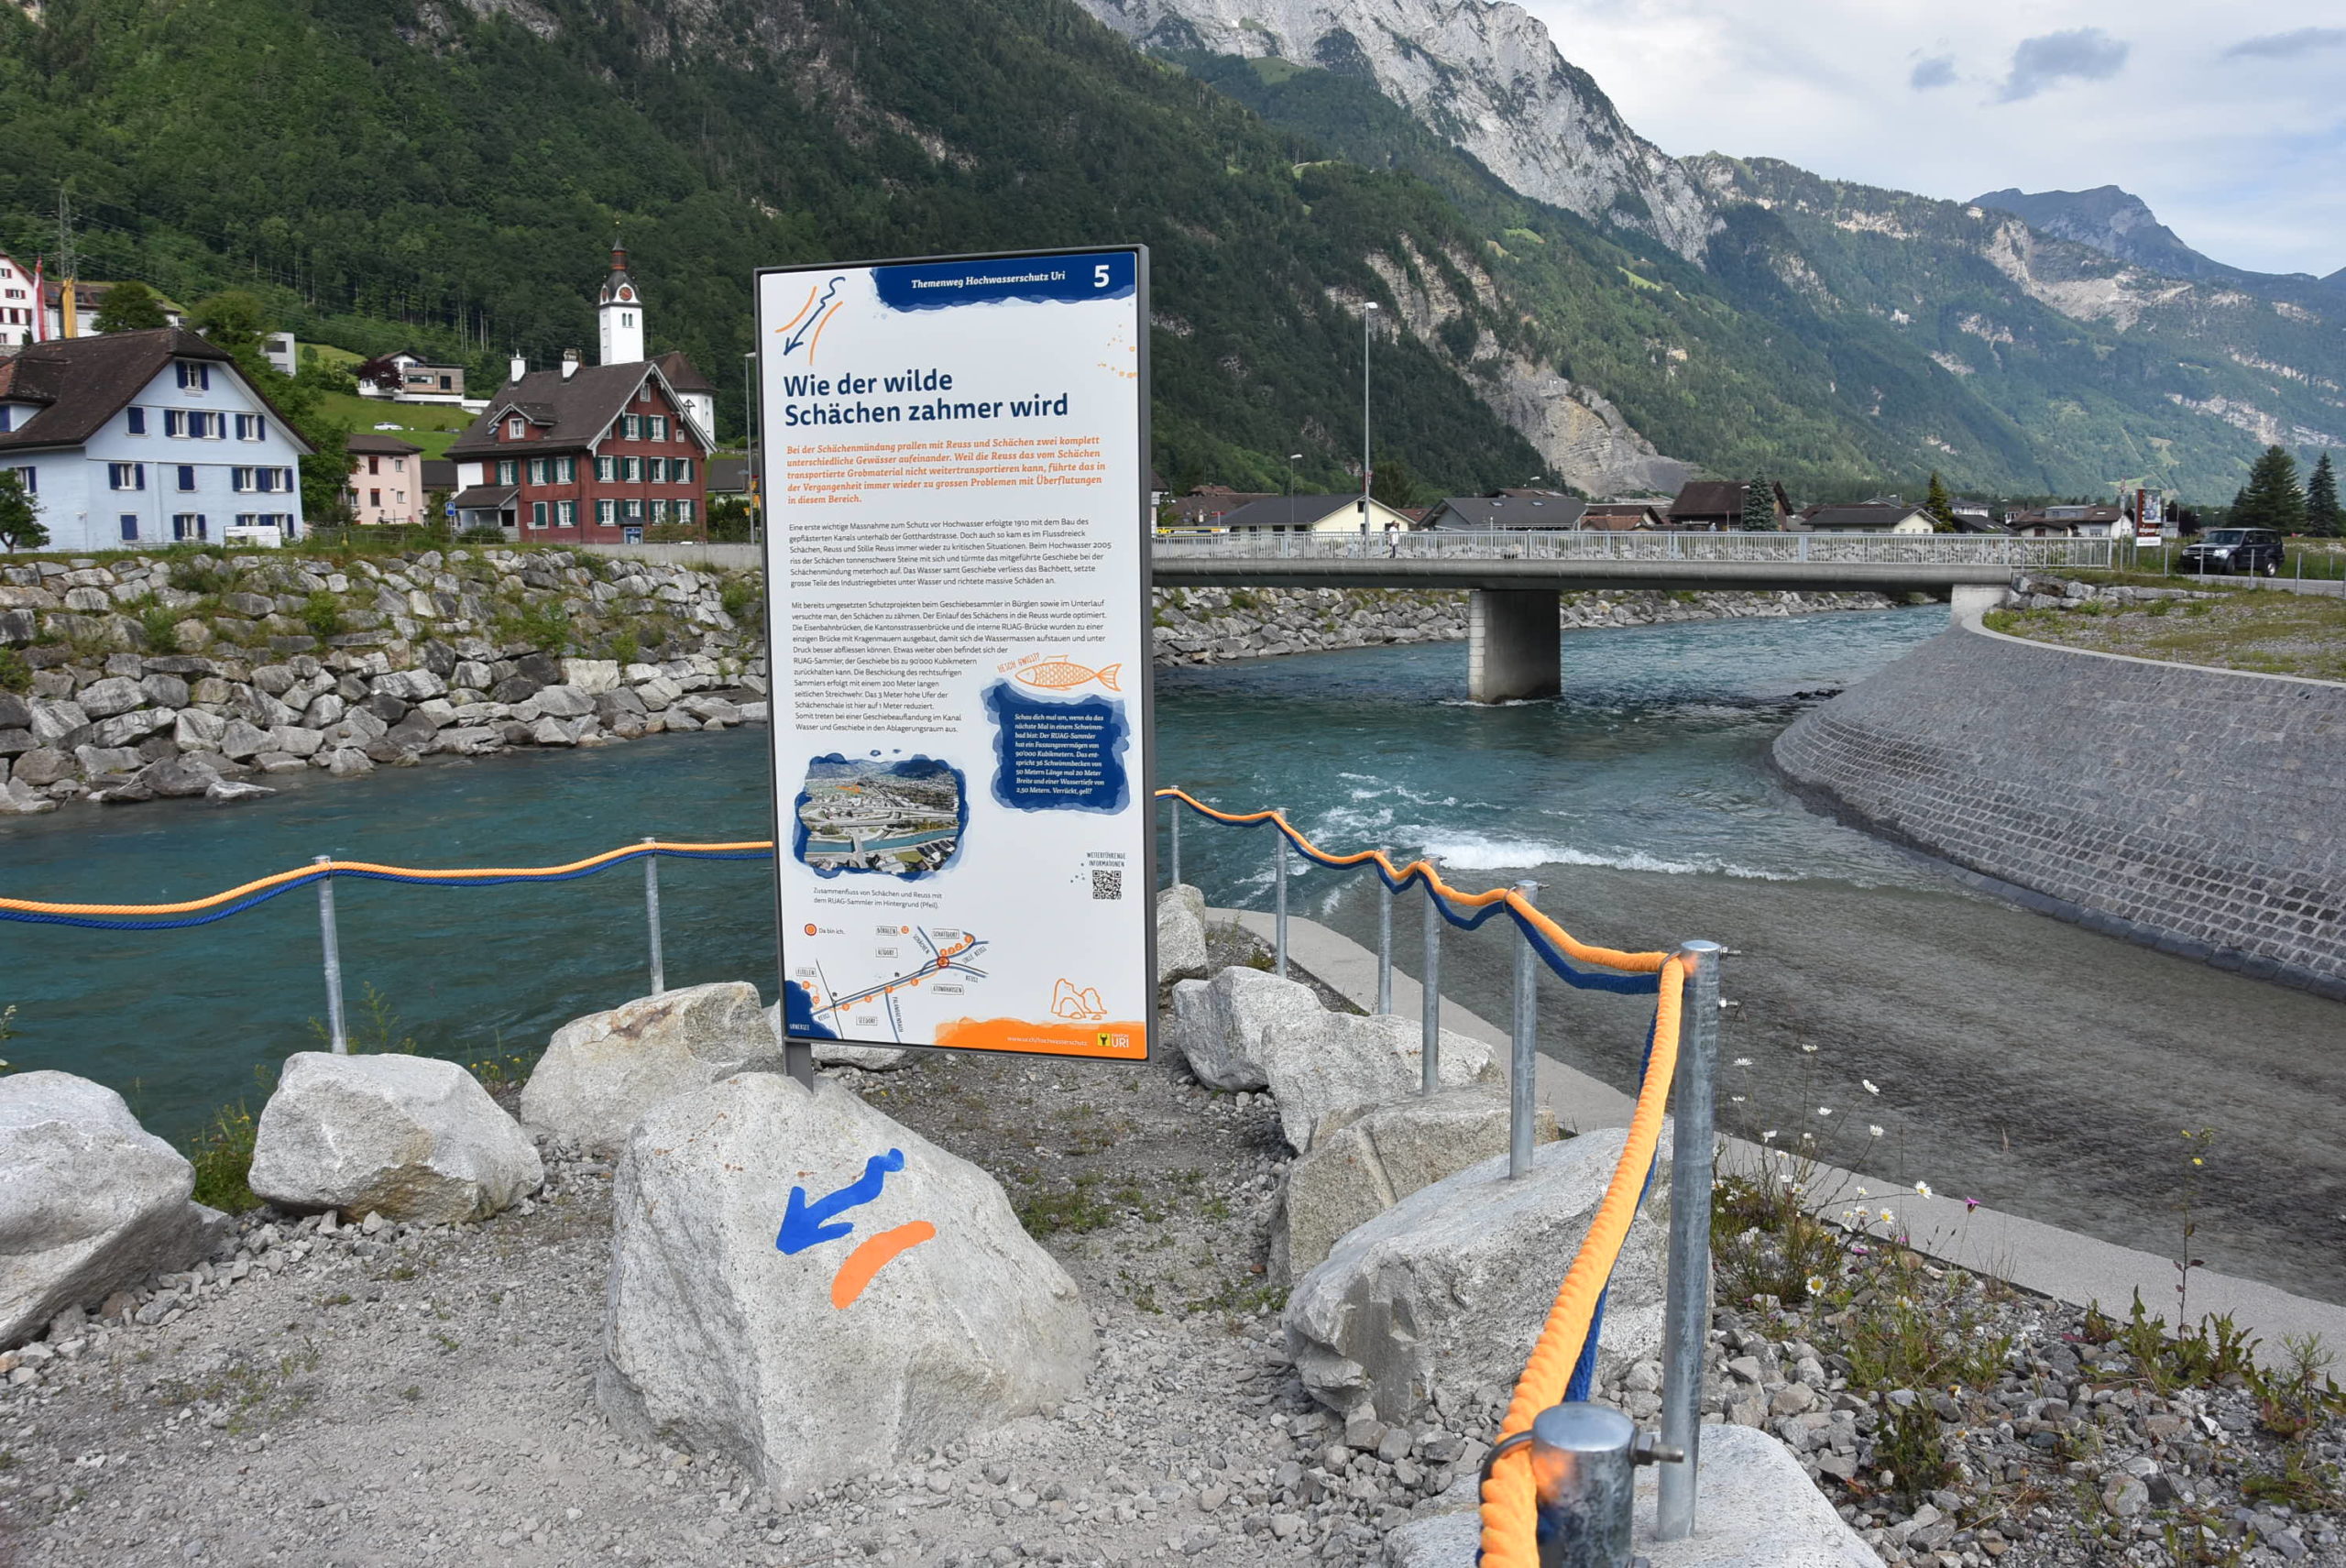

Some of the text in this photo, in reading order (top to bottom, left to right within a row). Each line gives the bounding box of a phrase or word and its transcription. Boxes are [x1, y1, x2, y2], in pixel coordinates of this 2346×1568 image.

[911, 270, 1065, 291] Themenweg Hochwasserschutz Uri
[1093, 264, 1109, 288] 5
[784, 367, 952, 397] Wie der wilde
[784, 391, 1068, 426] Schächen zahmer wird
[786, 434, 1099, 455] Bei der Schächenmündung prallen mit Reuss und Schächen zwei komplett
[786, 455, 853, 466] unterschiedliche
[855, 455, 896, 465] Gewässer
[898, 452, 951, 464] aufeinander.
[954, 452, 973, 461] Weil
[975, 451, 989, 460] die
[991, 450, 1016, 460] Reuss
[1018, 450, 1035, 459] das
[1057, 448, 1100, 458] Schächen
[786, 461, 1105, 481] transportierte Grobmaterial nicht weitertransportieren kann, führte das in
[786, 483, 801, 491] der
[803, 480, 861, 493] Vergangenheit
[863, 480, 891, 489] immer
[892, 478, 921, 488] wieder
[935, 480, 968, 489] grossen
[970, 477, 1016, 487] Problemen
[1018, 476, 1034, 485] mit
[1036, 473, 1102, 488] Überflutungen
[787, 493, 861, 504] in diesem Bereich.
[821, 522, 849, 532] wichtige
[850, 521, 889, 530] Massnahme
[905, 521, 928, 529] Schutz
[942, 520, 983, 528] Hochwasser
[984, 519, 1013, 529] erfolgte
[788, 533, 832, 543] gepflästerten
[856, 532, 889, 541] unterhalb
[902, 532, 959, 540] Gotthardstrasse.
[959, 531, 977, 539] Doch
[1042, 529, 1085, 537] Flussdreieck
[789, 545, 822, 554] Schächen,
[874, 543, 894, 552] Reuss
[951, 542, 985, 551] kritischen
[986, 542, 1027, 550] Situationen.
[1048, 541, 1091, 549] Hochwasser
[825, 602, 867, 610] umgesetzten
[868, 600, 921, 609] Schutzprojekten
[939, 599, 1003, 608] Geschiebesammler
[1012, 599, 1038, 609] Bürglen
[1070, 598, 1104, 607] Unterlauf
[793, 657, 844, 665] RUAG-Sammler,
[909, 657, 933, 665] 90'000
[826, 679, 848, 688] erfolgt
[916, 680, 939, 688] langen
[832, 723, 865, 731] Geschiebe
[885, 724, 944, 734] Ablagerungsraum
[813, 886, 859, 895] Zusammenfluss
[871, 889, 899, 897] Schächen
[827, 897, 873, 905] RUAG-Sammler
[882, 900, 919, 909] Hintergrund
[919, 901, 939, 909] (Pfeil).
[1112, 1037, 1129, 1048] URI
